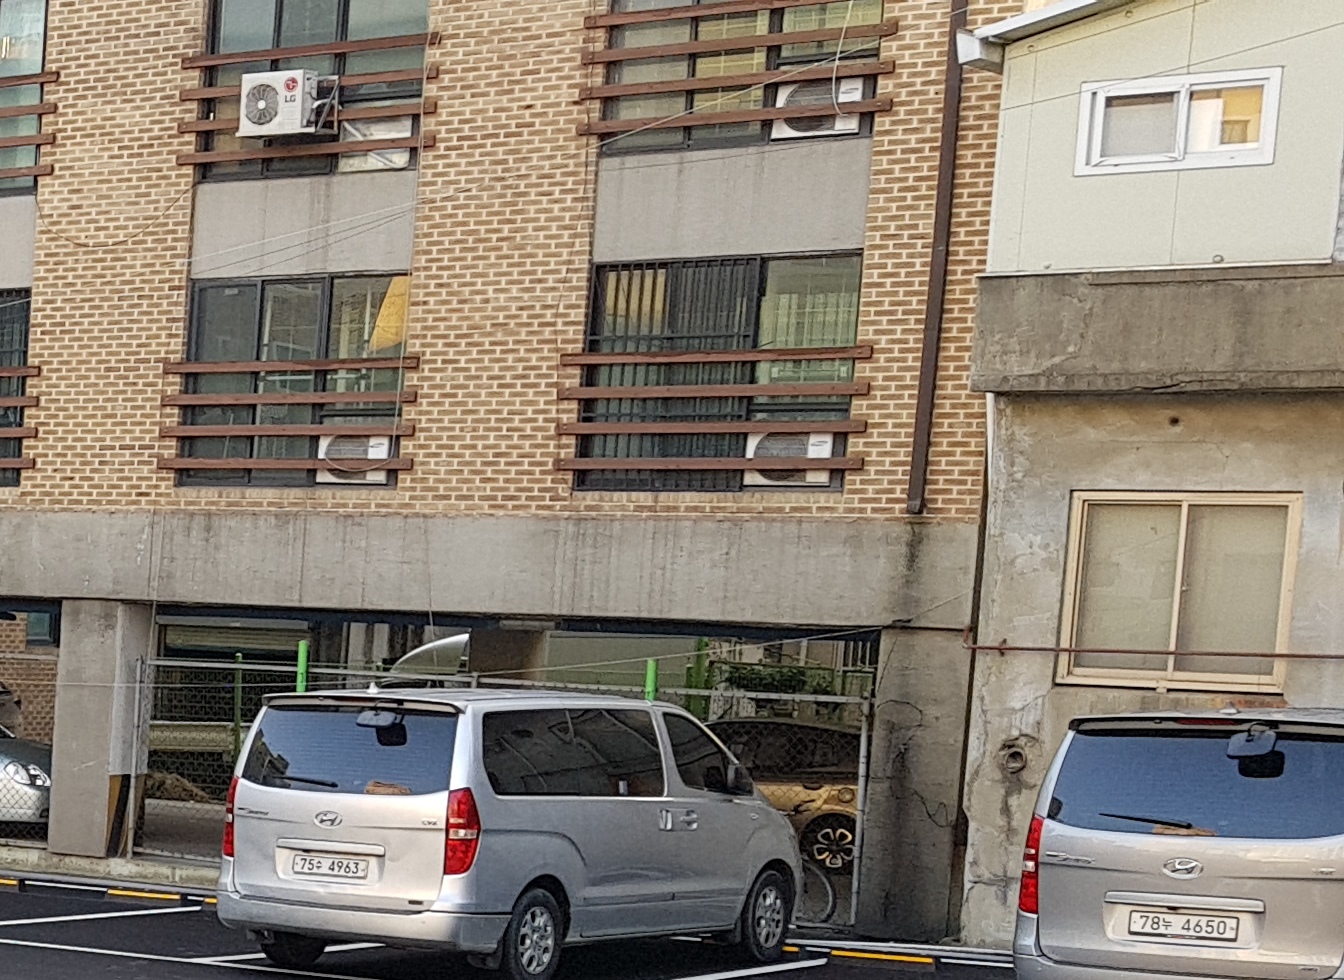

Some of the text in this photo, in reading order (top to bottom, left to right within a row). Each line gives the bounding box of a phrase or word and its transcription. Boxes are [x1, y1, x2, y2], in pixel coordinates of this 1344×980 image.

[284, 94, 297, 103] LG
[328, 860, 360, 875] 4963
[1139, 915, 1227, 936] 78누 4650
